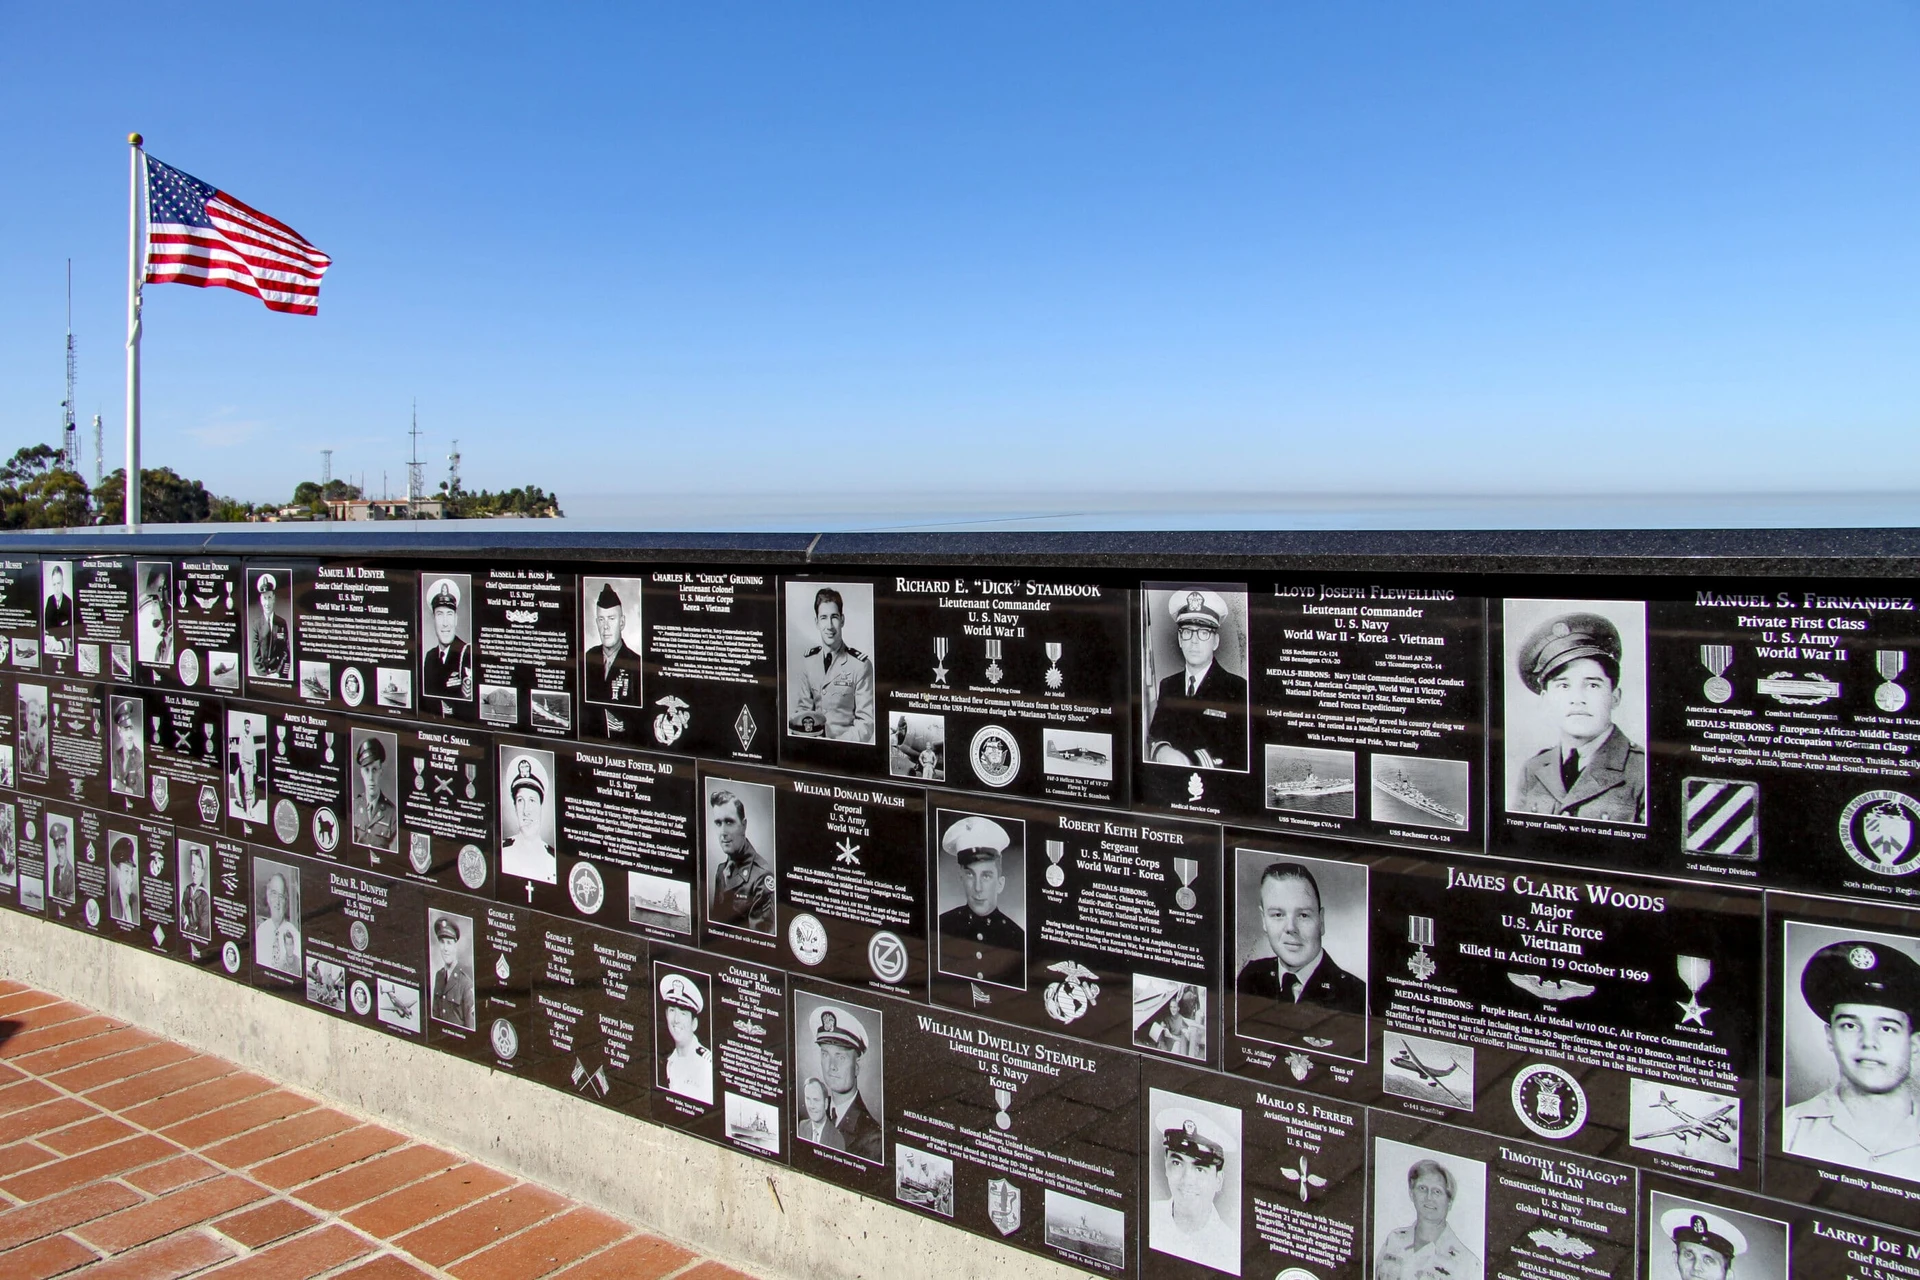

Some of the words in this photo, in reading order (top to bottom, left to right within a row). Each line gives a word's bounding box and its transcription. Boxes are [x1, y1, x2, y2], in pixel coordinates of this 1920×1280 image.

[319, 567, 344, 577] SAMUEL
[347, 568, 356, 577] M.
[358, 568, 385, 578] DENYER
[653, 572, 683, 582] CHARLES
[685, 574, 693, 582] R.
[730, 574, 763, 584] GRUNING
[896, 578, 950, 593] RICHARD
[955, 580, 968, 593] E.
[1027, 581, 1101, 596] STAMBOOK
[1275, 584, 1315, 597] LLOYD
[1320, 586, 1365, 600] JOSEPH
[1371, 586, 1454, 601] FLEWELLING
[940, 598, 989, 609] Lieutenant
[992, 599, 1050, 610] Commander
[1695, 592, 1770, 607] MANUEL
[1777, 593, 1795, 608] S.
[1804, 594, 1913, 610] FERNANDEZ
[969, 612, 979, 621] U.
[982, 613, 990, 622] S.
[994, 613, 1019, 626] Navy
[1303, 605, 1357, 615] Lieutenant
[1361, 607, 1423, 617] Commander
[964, 625, 991, 635] World
[995, 626, 1014, 636] War
[1018, 628, 1024, 637] II
[1335, 619, 1345, 628] U.
[1349, 619, 1358, 628] S.
[1362, 620, 1389, 631] Navy
[1738, 616, 1786, 627] Private
[1791, 617, 1823, 628] First
[1828, 617, 1865, 629] Class
[1284, 630, 1313, 639] World
[1316, 631, 1337, 640] War
[1340, 632, 1347, 641] II
[1358, 633, 1388, 643] Korea
[1400, 634, 1444, 645] Vietnam
[1762, 632, 1777, 642] U.
[1782, 633, 1794, 643] S.
[1799, 633, 1838, 647] Army
[1756, 647, 1797, 658] World
[1802, 649, 1831, 660] War
[1835, 650, 1845, 660] II
[1362, 704, 1406, 713] Expeditionary
[1719, 708, 1752, 716] Campaign
[1793, 712, 1837, 720] Infantryman
[418, 731, 441, 742] EDMUND
[443, 735, 449, 743] C.
[451, 736, 470, 746] SMALL
[1704, 731, 1745, 742] Campaign,
[1748, 734, 1771, 744] Army
[1773, 735, 1783, 743] of
[1784, 737, 1832, 746] Occupation
[1883, 743, 1908, 752] Clasp
[577, 752, 603, 764] DONALD
[605, 756, 626, 767] JAMES
[628, 759, 656, 772] FOSTER,
[658, 763, 672, 774] MD
[593, 769, 621, 778] Lieutenant
[622, 773, 654, 783] Commander
[794, 782, 831, 796] WILLIAM
[834, 787, 869, 802] DONALD
[872, 792, 904, 807] WALSH
[834, 804, 862, 814] Corporal
[1059, 816, 1100, 832] ROBERT
[1105, 822, 1137, 838] KEITH
[1142, 827, 1184, 844] FOSTER
[1101, 841, 1138, 853] Sergeant
[1081, 849, 1090, 858] U.
[1093, 851, 1100, 859] S.
[1103, 853, 1133, 864] Marine
[1135, 857, 1160, 869] Corps
[1700, 865, 1727, 874] Infantry
[1729, 868, 1756, 876] Division
[331, 874, 348, 886] DEAN
[351, 878, 358, 889] R.
[361, 881, 387, 897] DUNPHY
[1447, 867, 1505, 891] JAMES
[1513, 876, 1579, 901] CLARK
[1586, 884, 1664, 912] WOODS
[1531, 902, 1573, 919] Major
[1502, 915, 1529, 930] U.S.
[1535, 920, 1558, 934] Air
[1563, 924, 1602, 940] Force
[546, 932, 566, 943] GEORGE
[568, 937, 573, 945] F.
[1521, 934, 1582, 954] Vietnam
[545, 942, 574, 955] WALDHAUS
[594, 944, 615, 956] ROBERT
[617, 950, 636, 962] JOSEPH
[600, 956, 631, 971] WALDHAUS
[1460, 944, 1491, 957] Killed
[1495, 949, 1505, 959] in
[1509, 952, 1546, 966] Action
[1552, 958, 1565, 968] 19
[1569, 961, 1615, 976] October
[1620, 969, 1649, 981] 1969
[729, 966, 758, 980] CHARLES
[760, 973, 769, 983] M.
[755, 980, 782, 996] REMOLL
[918, 1015, 973, 1042] WILLIAM
[978, 1030, 1030, 1056] DWELLY
[1035, 1045, 1096, 1072] STEMPLE
[950, 1041, 999, 1061] Lieutenant
[1002, 1054, 1060, 1076] Commander
[979, 1061, 988, 1071] U.
[992, 1064, 1000, 1074] S.
[1004, 1067, 1028, 1083] Navy
[990, 1076, 1017, 1091] Korea
[1256, 1093, 1294, 1111] MARLO
[1298, 1103, 1308, 1114] S.
[1313, 1106, 1353, 1125] FERRER
[1264, 1111, 1290, 1123] Aviation
[1292, 1117, 1327, 1132] Machinist's
[1329, 1126, 1345, 1136] Mate
[1286, 1126, 1303, 1136] Third
[1305, 1131, 1321, 1141] Class
[1500, 1147, 1554, 1172] TIMOTHY
[1541, 1169, 1583, 1189] MILAN
[1818, 1169, 1840, 1181] Your
[1841, 1175, 1869, 1189] family
[1871, 1182, 1903, 1196] honors
[1498, 1176, 1546, 1194] Construction
[1548, 1188, 1584, 1204] Mechanic
[1586, 1198, 1604, 1208] First
[1606, 1203, 1626, 1214] Class
[1516, 1203, 1539, 1215] Global
[1542, 1209, 1557, 1219] War
[1571, 1215, 1607, 1232] Terrorism
[1813, 1220, 1867, 1246] LARRY
[1872, 1235, 1901, 1255] JOE
[1511, 1246, 1531, 1256] Seabee
[1532, 1252, 1554, 1262] Combat
[1556, 1258, 1580, 1269] Warfare
[1581, 1265, 1610, 1277] Specialist
[1847, 1250, 1874, 1264] Chief
